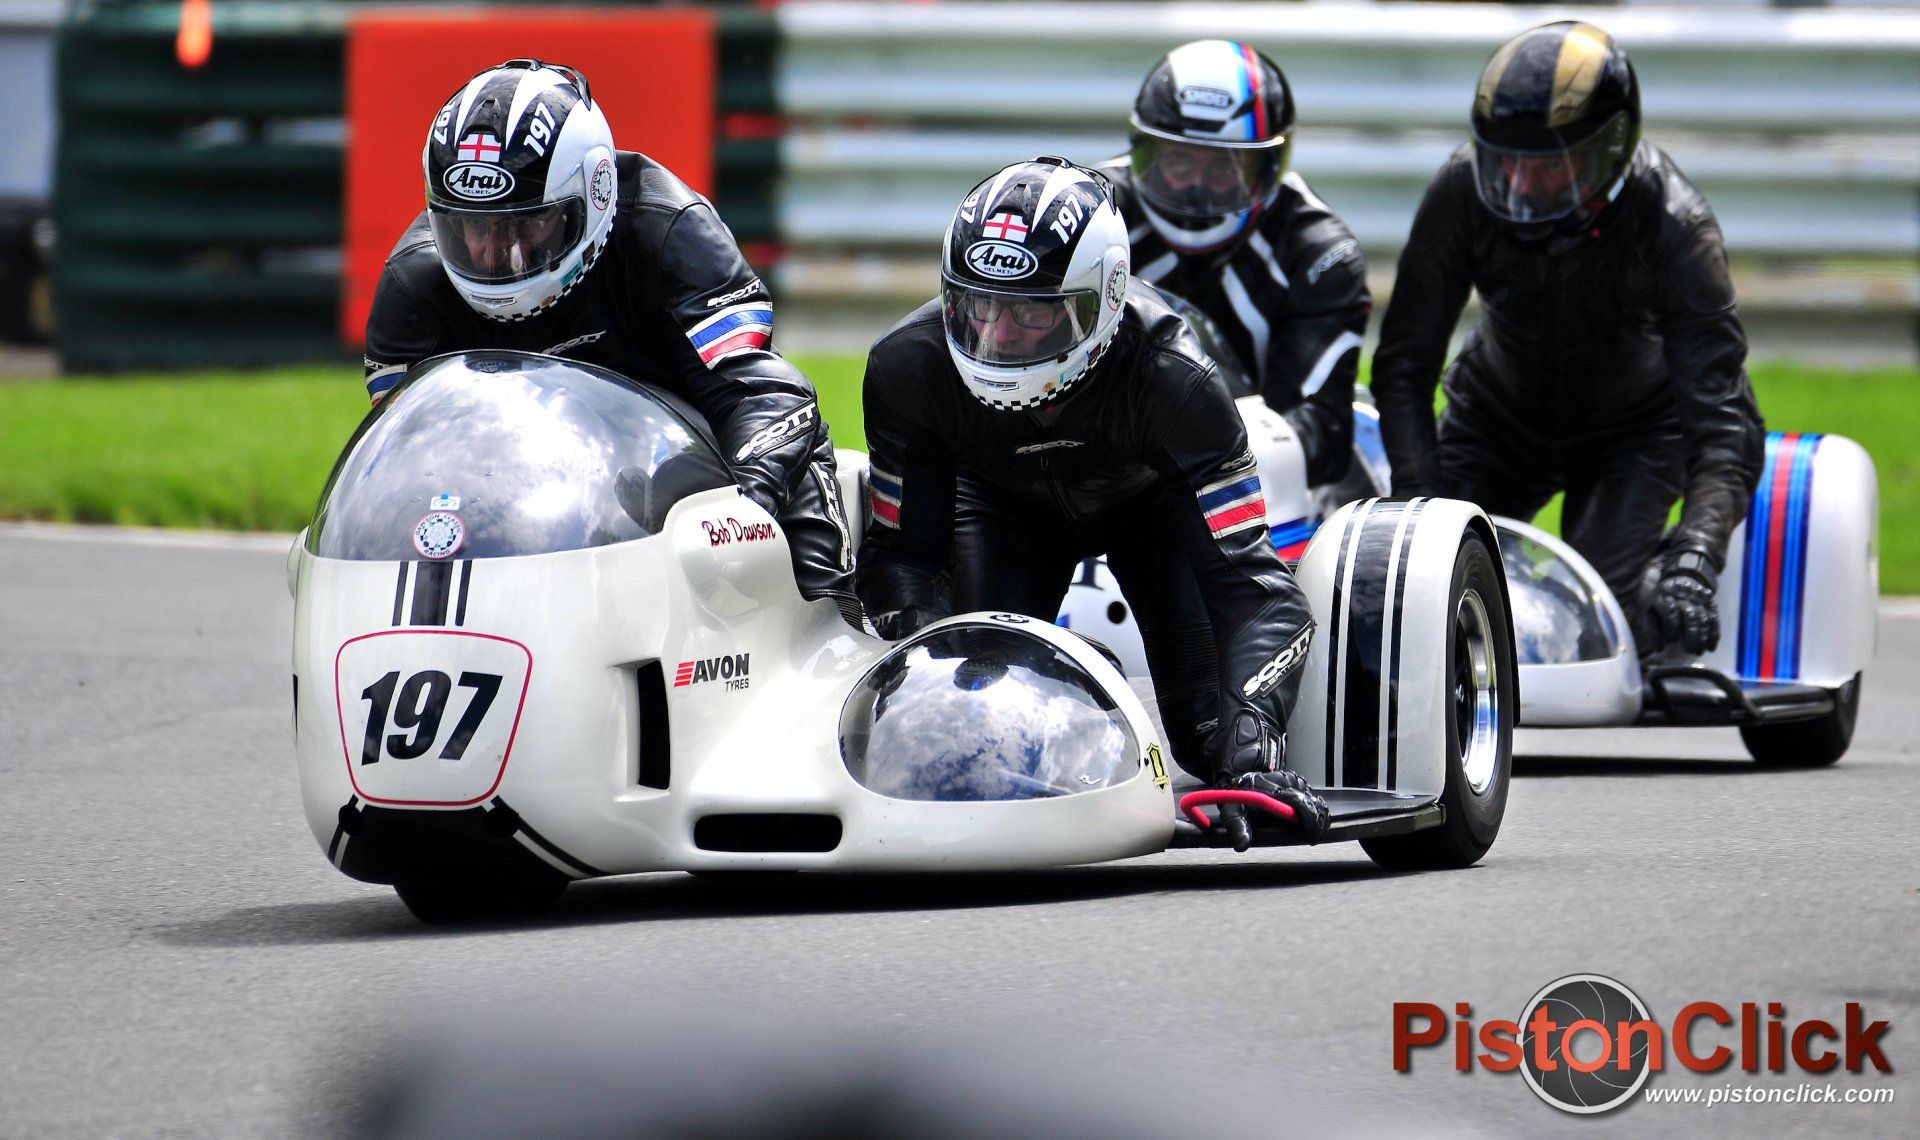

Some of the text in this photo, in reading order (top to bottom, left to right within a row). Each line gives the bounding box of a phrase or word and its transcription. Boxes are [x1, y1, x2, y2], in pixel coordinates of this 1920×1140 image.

[523, 101, 556, 158] 197
[449, 167, 504, 189] Arai
[960, 192, 981, 224] 97
[1049, 192, 1084, 245] 197
[970, 245, 1027, 270] Arai
[736, 402, 816, 461] SCOTT
[702, 517, 776, 547] Bob Dawson
[692, 653, 750, 684] AVON
[1243, 627, 1312, 696] SCOTT
[725, 678, 750, 692] TYRES
[361, 670, 503, 766] 197
